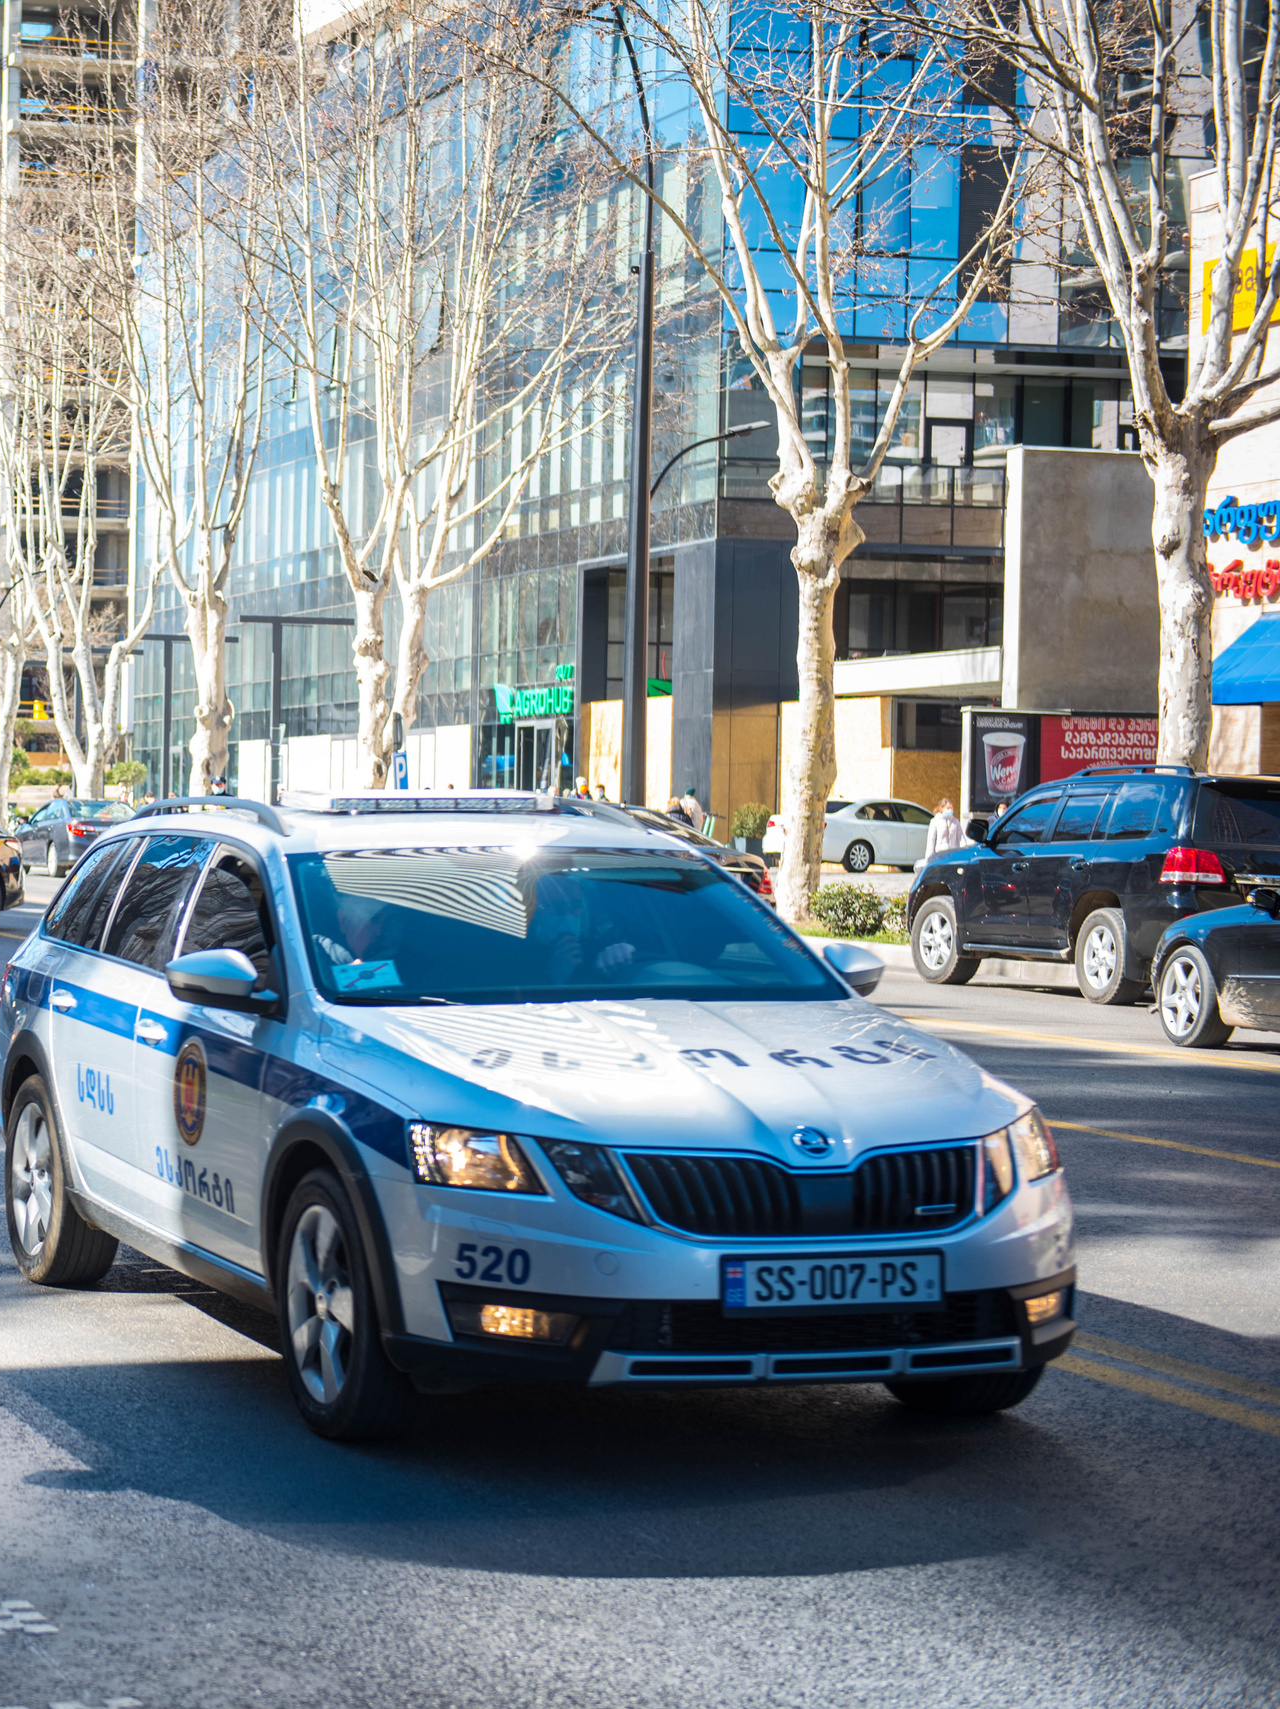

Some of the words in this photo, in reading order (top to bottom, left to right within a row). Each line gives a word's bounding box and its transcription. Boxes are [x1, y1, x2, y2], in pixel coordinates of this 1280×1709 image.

[514, 686, 574, 717] AGROHUB
[1064, 731, 1156, 746] დამზადებულია
[395, 756, 406, 789] P
[155, 1145, 235, 1214] ესკორტი
[455, 1243, 531, 1286] 520
[755, 1261, 918, 1302] SS-007-PS
